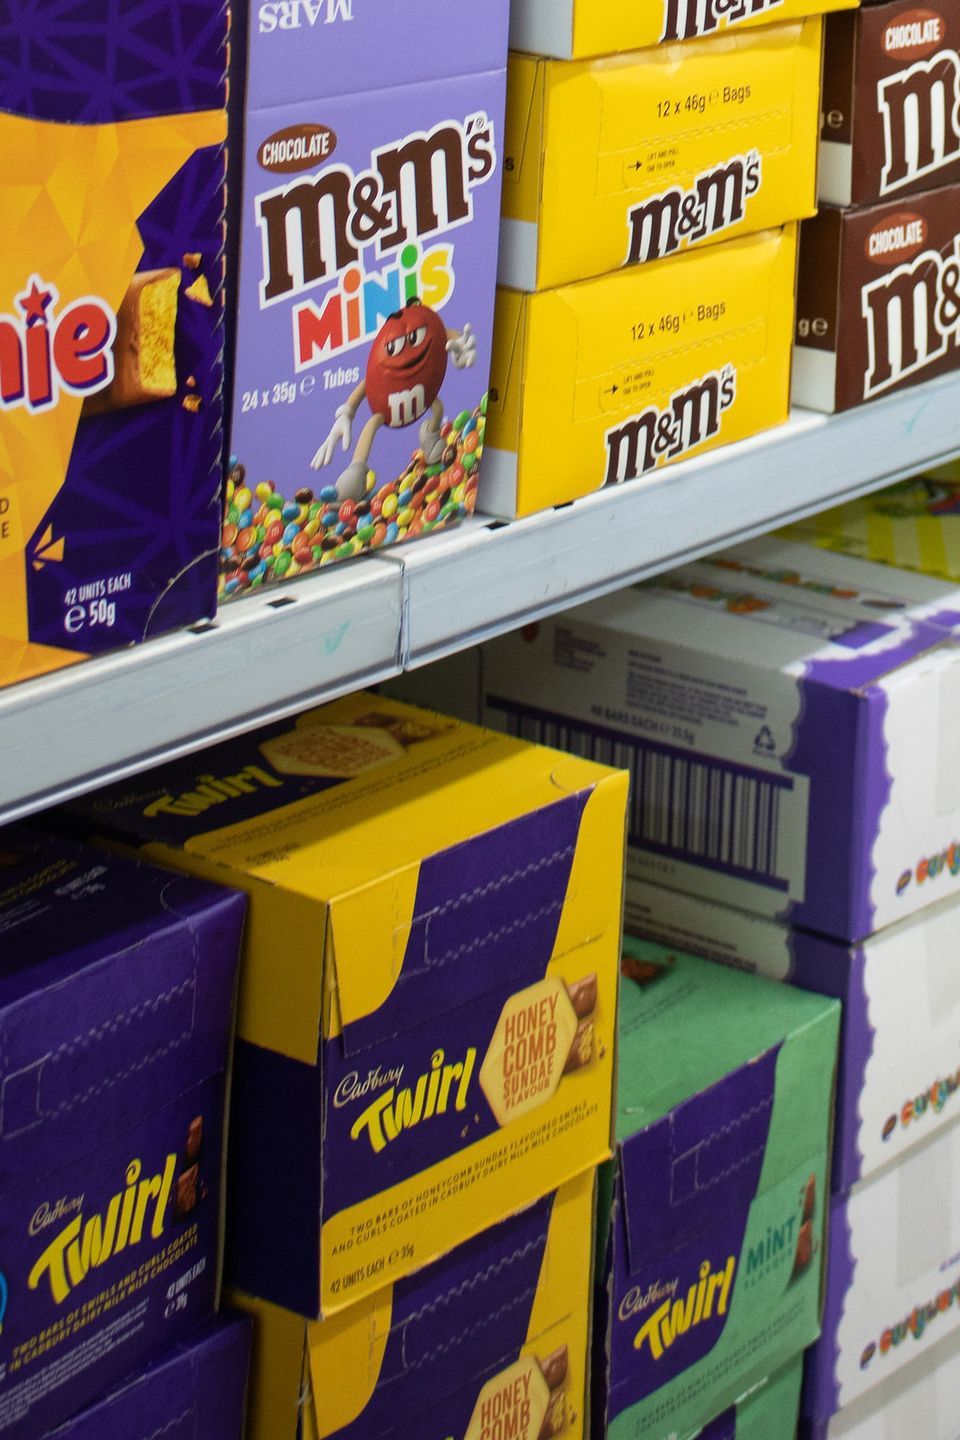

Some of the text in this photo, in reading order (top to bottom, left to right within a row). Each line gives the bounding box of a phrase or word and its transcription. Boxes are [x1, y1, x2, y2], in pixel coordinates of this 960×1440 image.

[884, 18, 941, 52] CHOCOLATE
[656, 84, 752, 119] 12 46g Bags
[261, 131, 331, 168] CHOCOLATE
[868, 219, 923, 257] CHOCOLATE
[629, 301, 726, 342] 12 46g Bags
[241, 366, 360, 413] 24 35g Tubes
[387, 383, 428, 429] m
[64, 571, 132, 607] 42 UNITS EACH
[88, 598, 116, 628] 50g
[142, 765, 285, 818] Twirl
[504, 990, 560, 1045] HONEY
[502, 1022, 558, 1079] COMB
[333, 1063, 405, 1109] Cadbury
[349, 1046, 477, 1154] Twirl
[503, 1055, 555, 1100] SUNDAE
[505, 1079, 551, 1111] FLAVOUR
[331, 1238, 354, 1257] AND
[355, 1223, 388, 1248] CURLS
[389, 1204, 427, 1230] COATED
[427, 1196, 439, 1209] IN
[440, 1172, 481, 1203] CADBURY
[482, 1160, 508, 1181] DAIRY
[509, 1149, 530, 1168] MILK
[551, 1103, 599, 1138] CHOCOLATE
[350, 1117, 558, 1236] TWO BARS OF HONEYCOMB SUNDAE FLAVOURED
[27, 1192, 85, 1237] Cadbury
[27, 1152, 178, 1305] Twirl
[329, 1254, 385, 1294] 42 UNITS EACH
[617, 1276, 679, 1322] Cadbury
[632, 1254, 736, 1361] Twirl
[479, 1367, 533, 1429] HONEY
